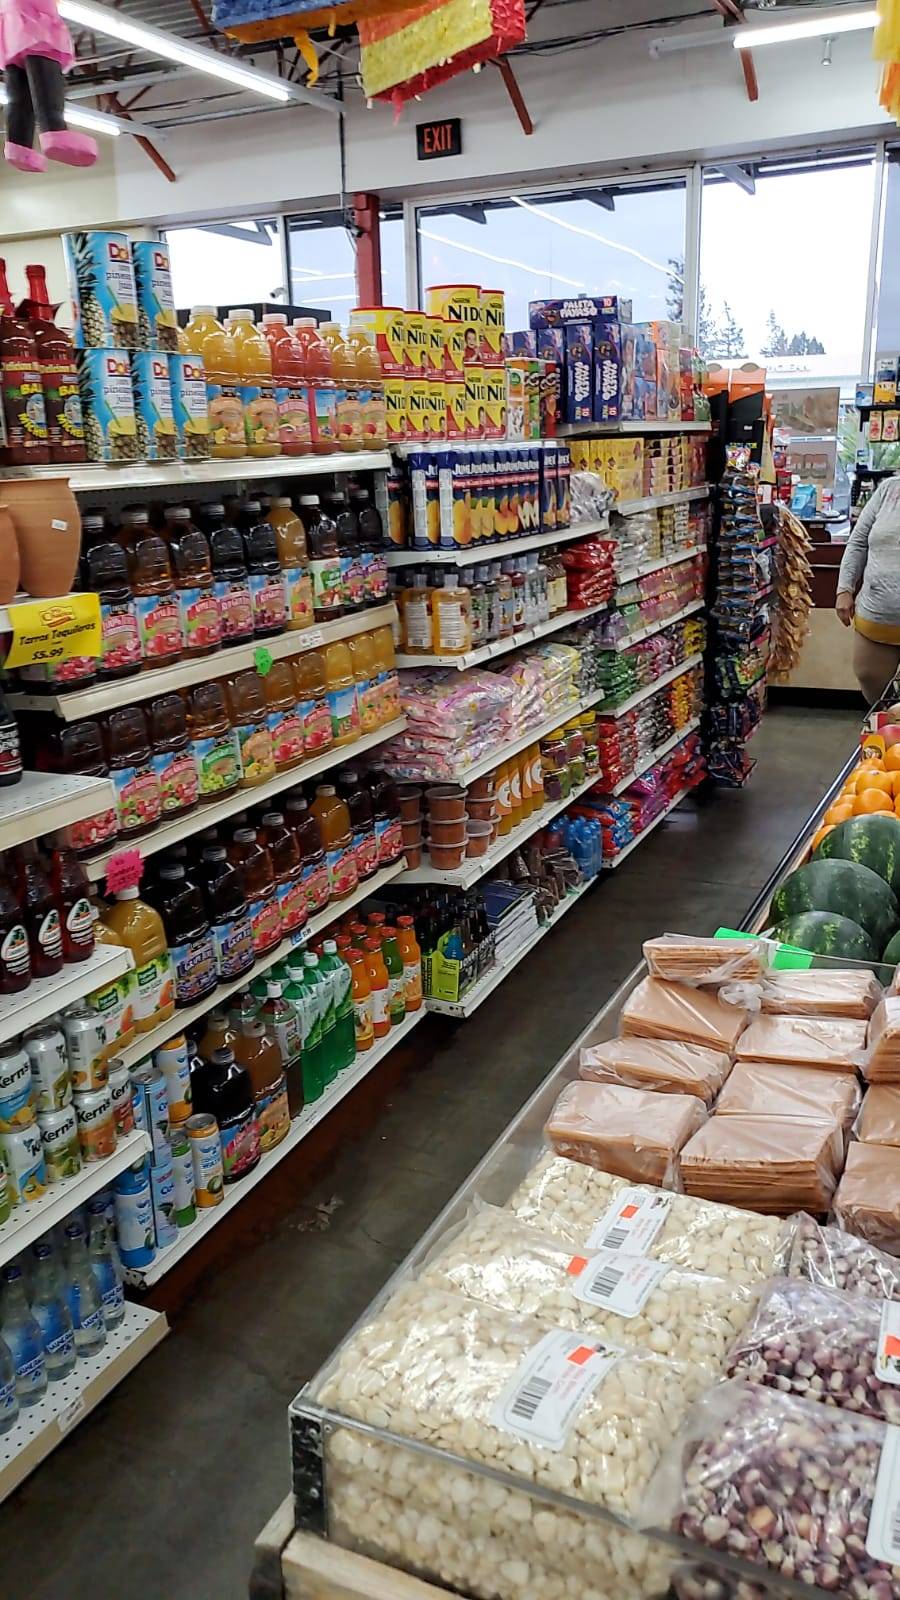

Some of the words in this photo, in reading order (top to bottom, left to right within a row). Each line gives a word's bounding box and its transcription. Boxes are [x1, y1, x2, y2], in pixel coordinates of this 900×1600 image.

[423, 124, 452, 153] EXIT
[77, 1098, 111, 1123] Kern's
[40, 1118, 74, 1143] Kern's
